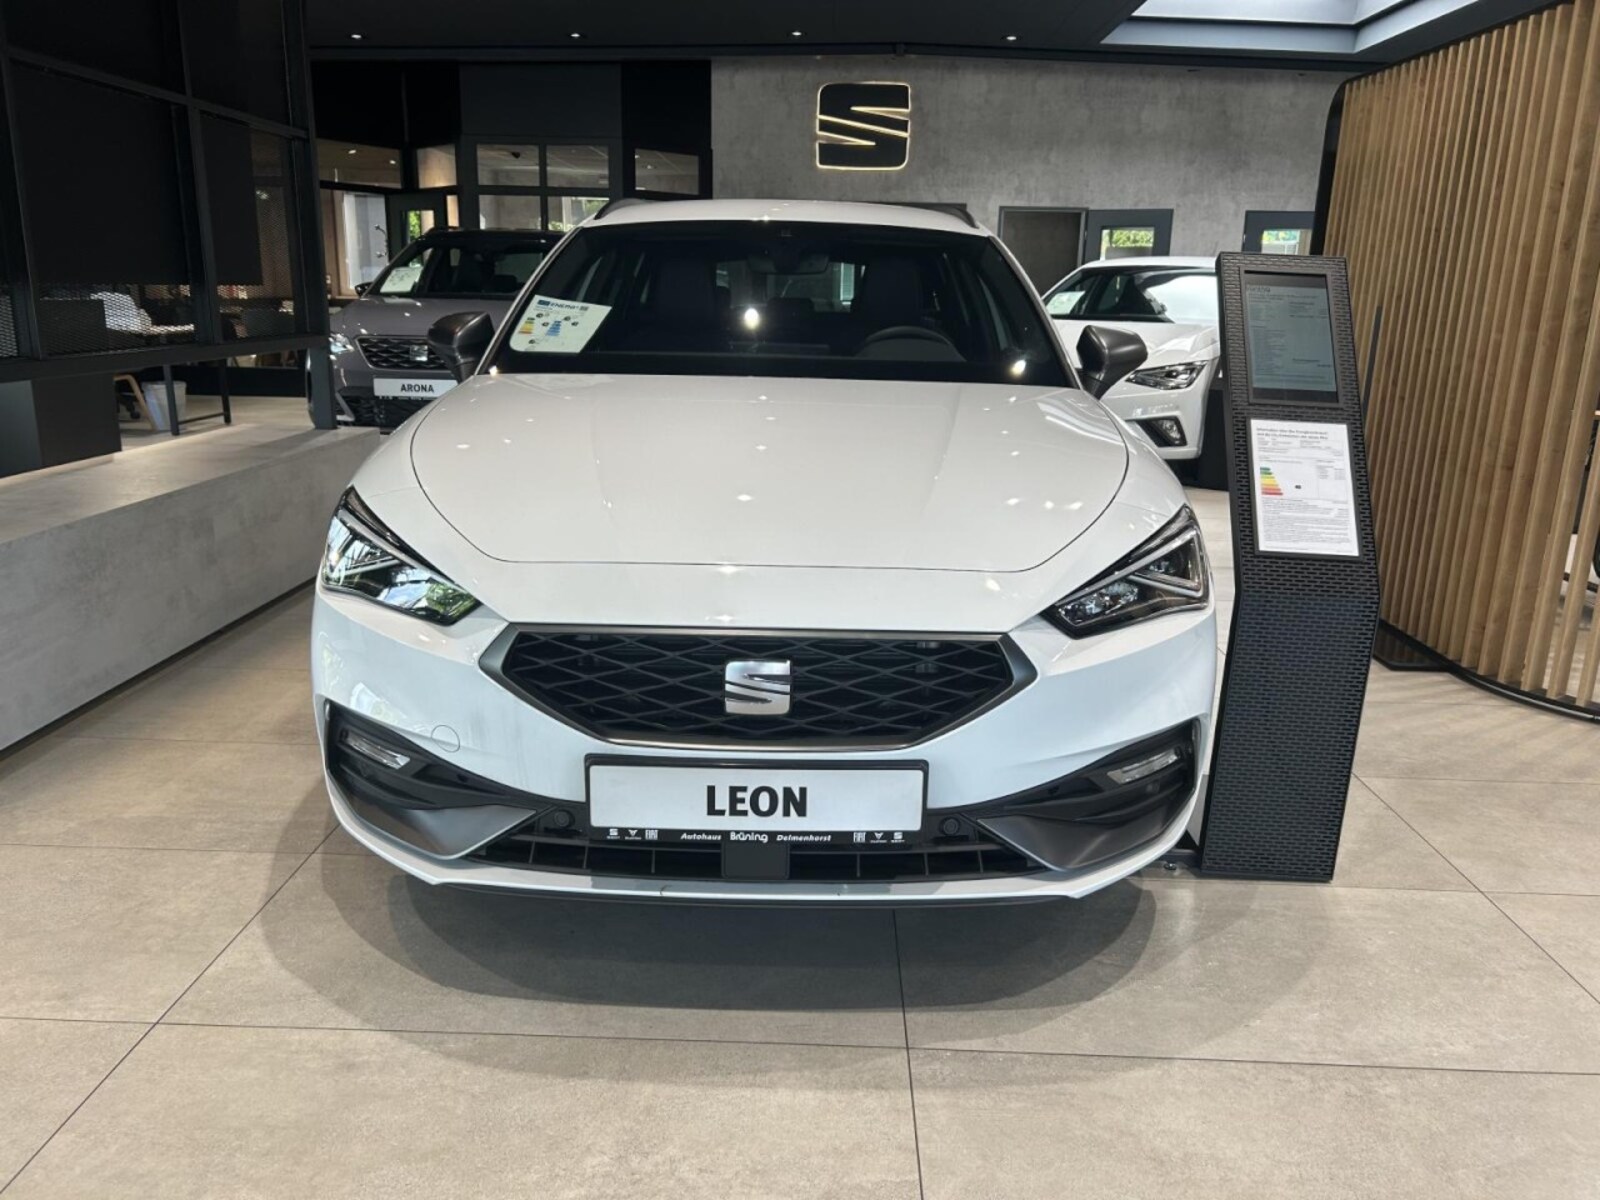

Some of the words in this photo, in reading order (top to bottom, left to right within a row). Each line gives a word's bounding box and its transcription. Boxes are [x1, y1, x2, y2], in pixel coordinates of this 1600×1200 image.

[400, 384, 434, 393] ARONA
[706, 785, 807, 818] LEON
[680, 832, 722, 841] Autohaus
[730, 831, 768, 844] Brüning
[776, 834, 832, 842] Delmenhorst
